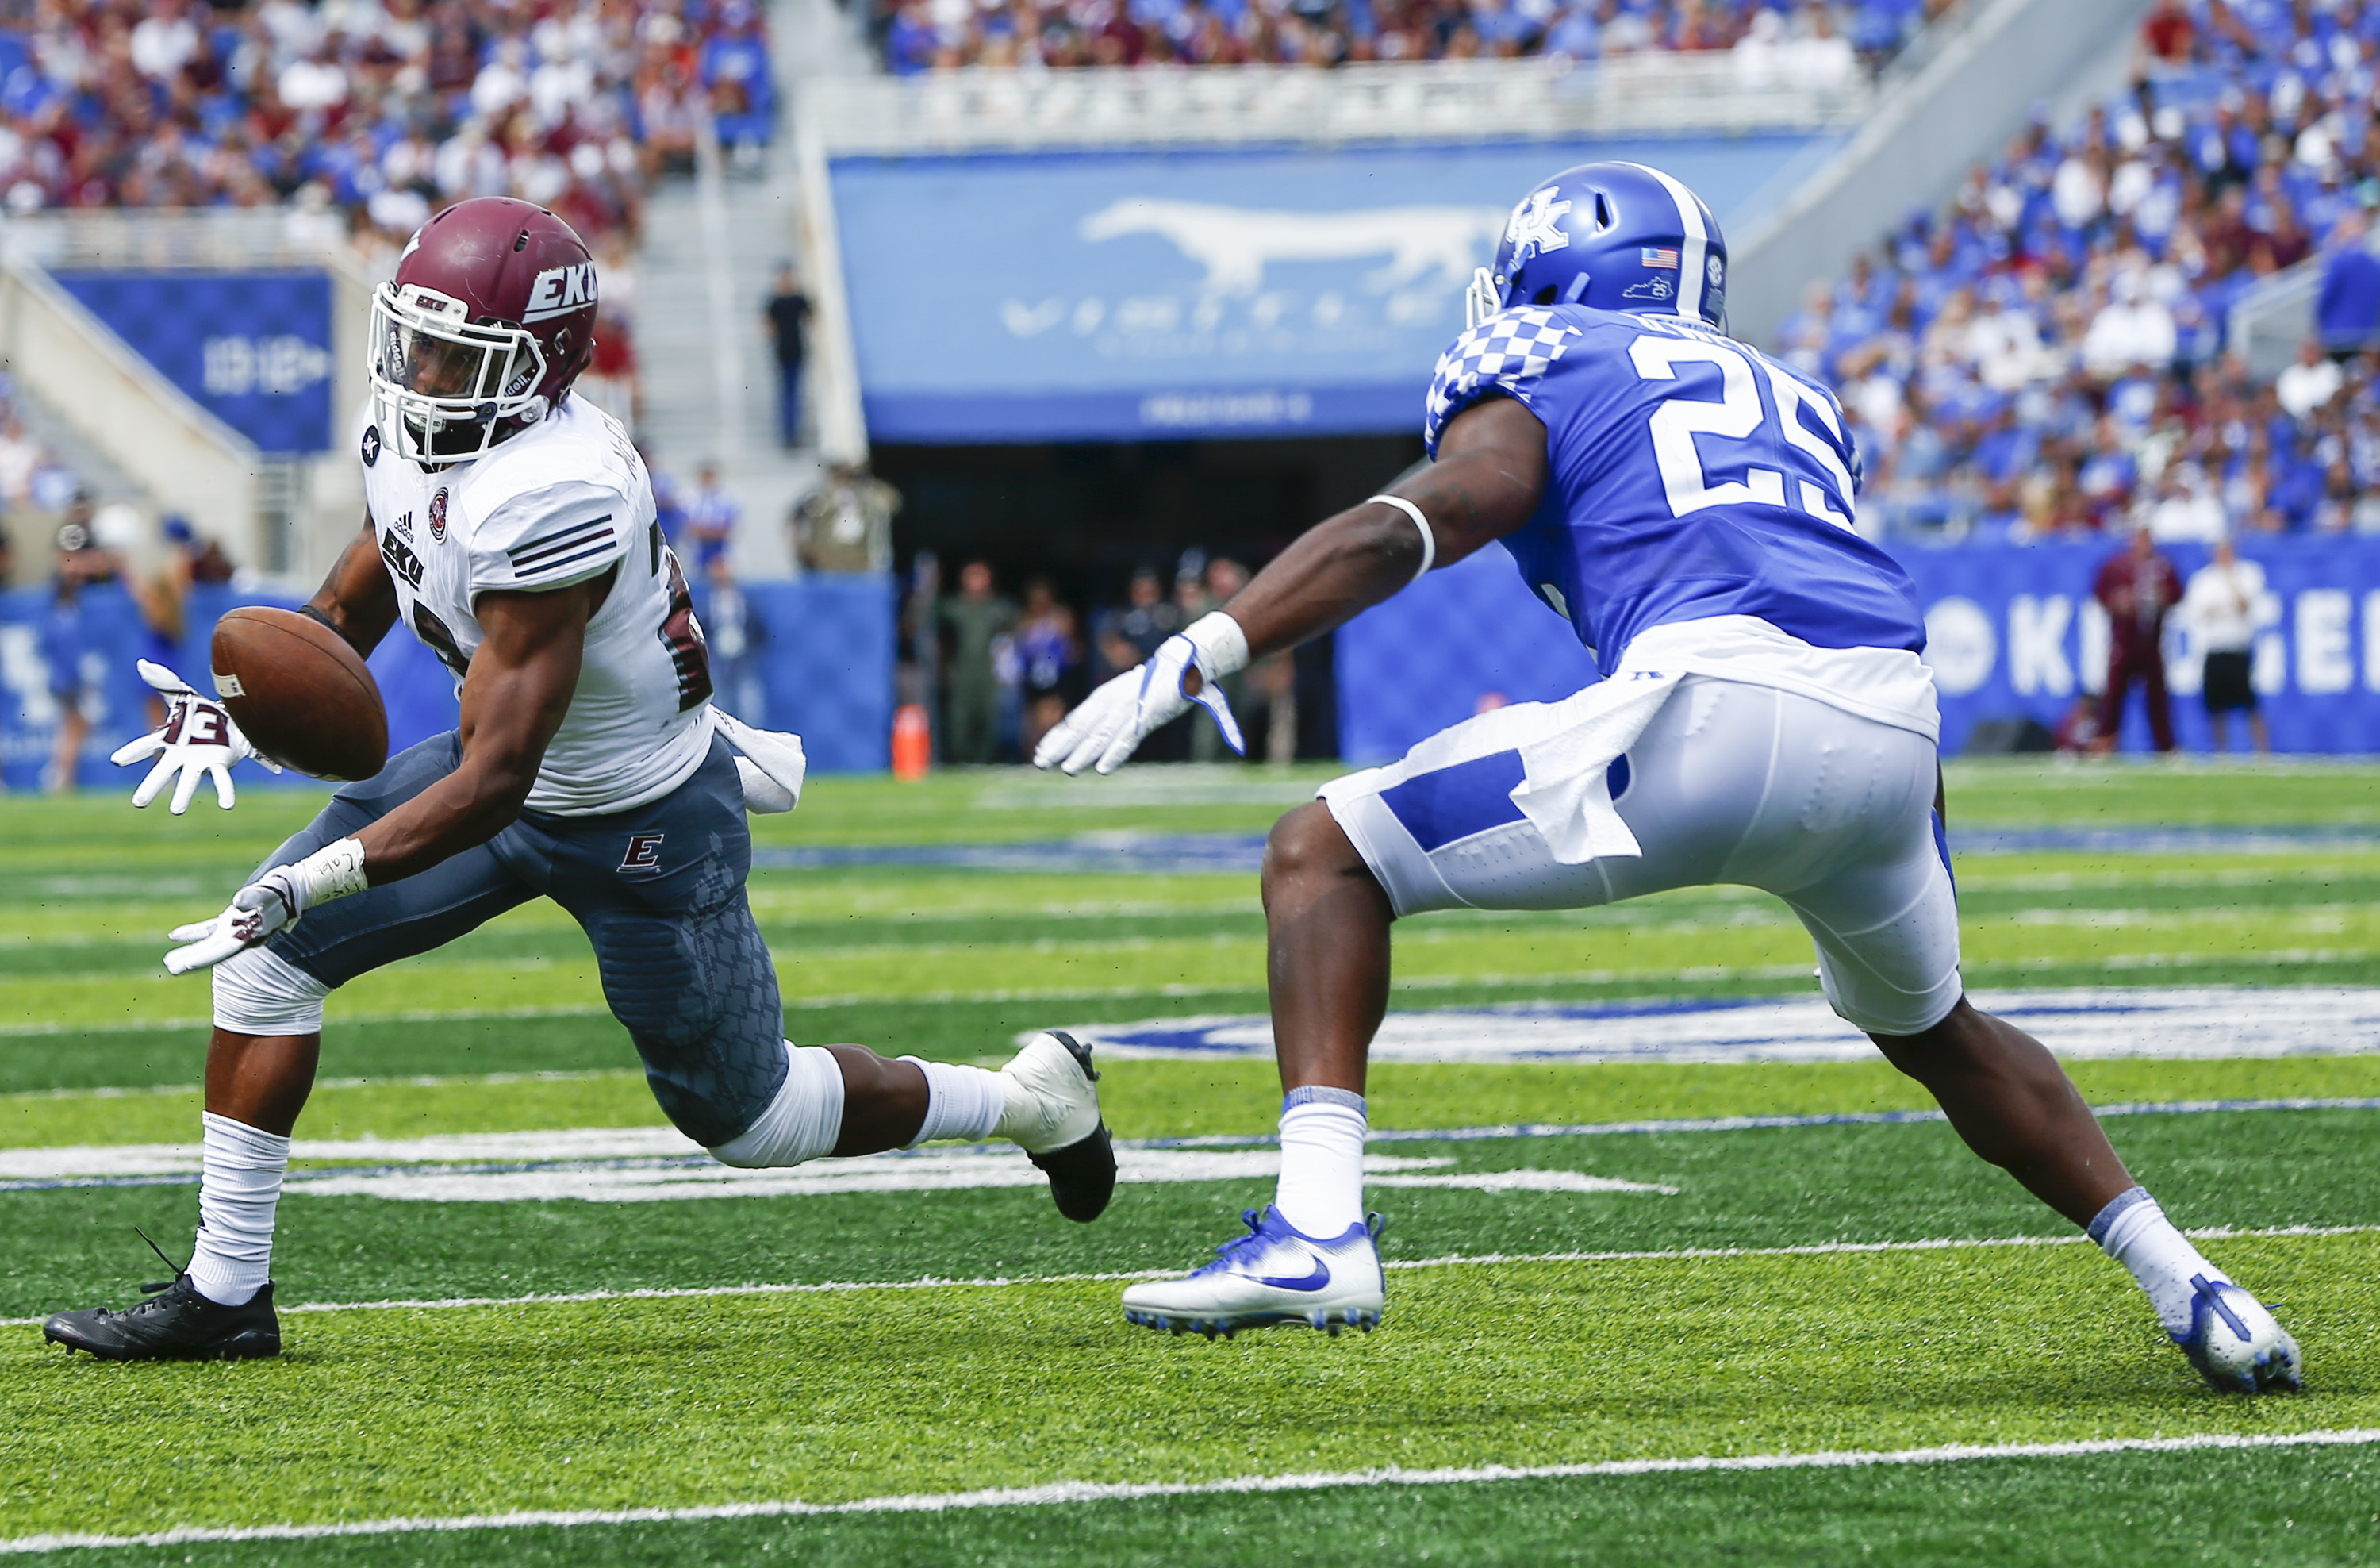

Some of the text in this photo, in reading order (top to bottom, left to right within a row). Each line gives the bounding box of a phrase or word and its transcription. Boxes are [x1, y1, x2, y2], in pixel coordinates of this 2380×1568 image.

[524, 259, 598, 312] EKU
[1626, 334, 1859, 537] 25
[382, 527, 424, 586] EKU
[620, 833, 665, 867] E
